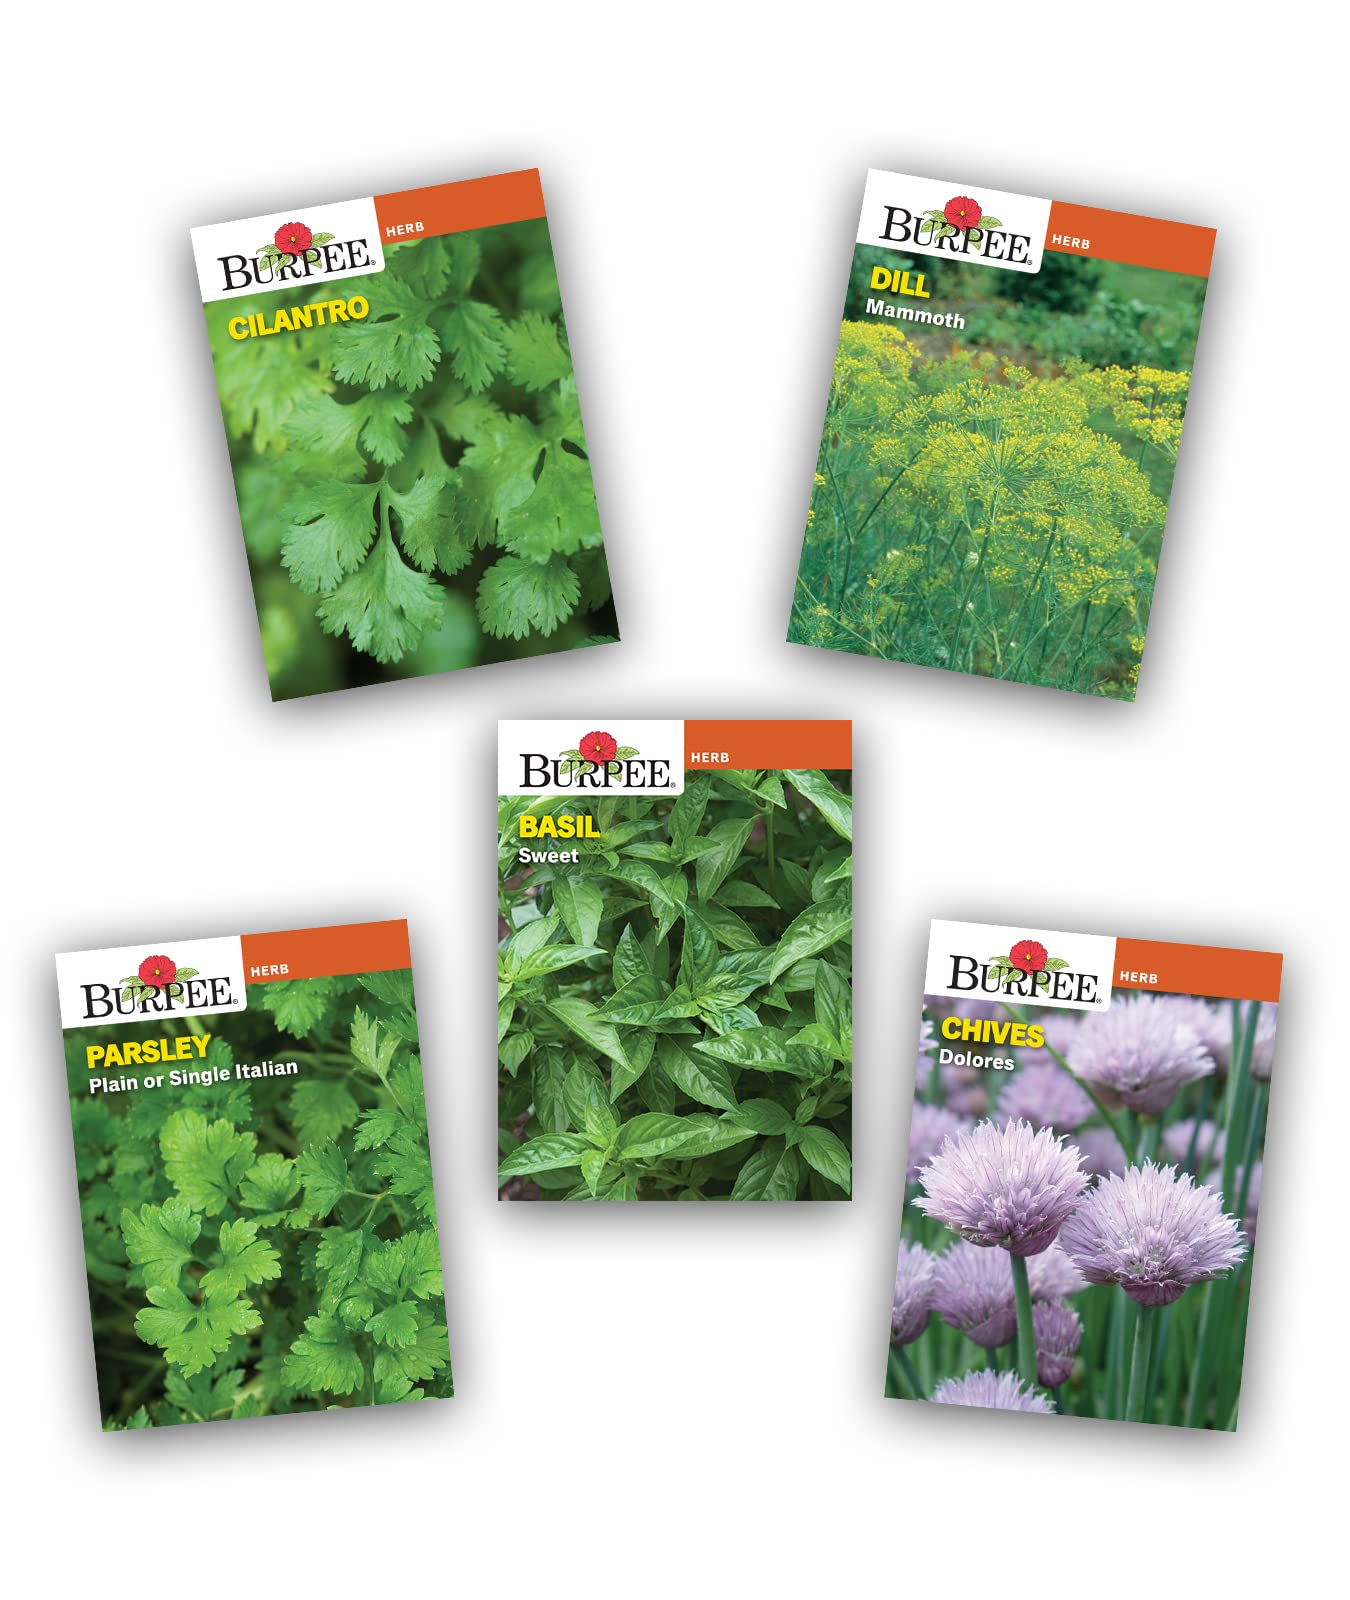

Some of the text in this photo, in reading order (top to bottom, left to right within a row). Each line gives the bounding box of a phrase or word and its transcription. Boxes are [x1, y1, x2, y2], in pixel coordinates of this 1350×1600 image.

[385, 221, 425, 237] HERB
[878, 205, 1031, 265] BURPEE
[1051, 233, 1091, 250] HERB
[217, 238, 371, 291] BURPEE
[869, 265, 931, 299] DILL
[227, 295, 370, 341] CILANTRO
[865, 298, 966, 330] Mammoth
[519, 753, 671, 788] BURPEE
[690, 752, 730, 764] HERB
[518, 815, 600, 839] BASIL
[518, 847, 579, 864] Sweet
[250, 963, 289, 977] HERB
[946, 954, 1099, 1004] BURPEE
[1119, 970, 1159, 985] HERB
[80, 976, 233, 1020] BURPEE
[941, 1016, 1045, 1049] CHIVES
[86, 1033, 212, 1069] PARSLEY
[938, 1048, 1015, 1072] Dolores
[89, 1060, 298, 1094] Plain or Single Italian
